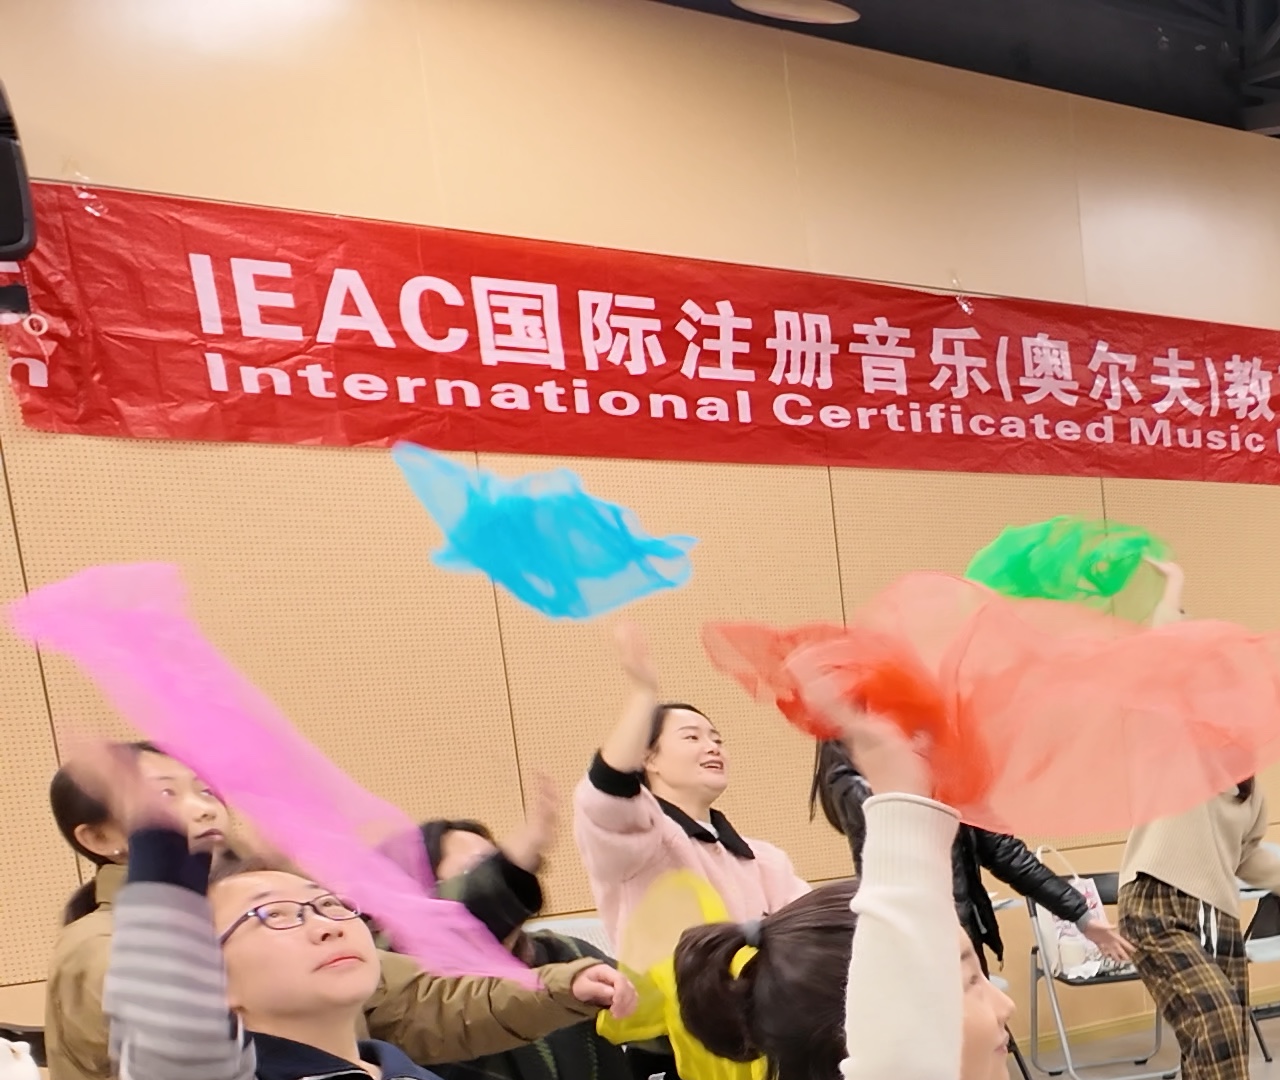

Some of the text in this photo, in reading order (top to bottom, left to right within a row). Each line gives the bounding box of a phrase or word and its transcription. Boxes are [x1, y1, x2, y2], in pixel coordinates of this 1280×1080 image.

[204, 353, 752, 425] International
[773, 392, 1115, 444] Certificated
[1130, 417, 1266, 454] Music
